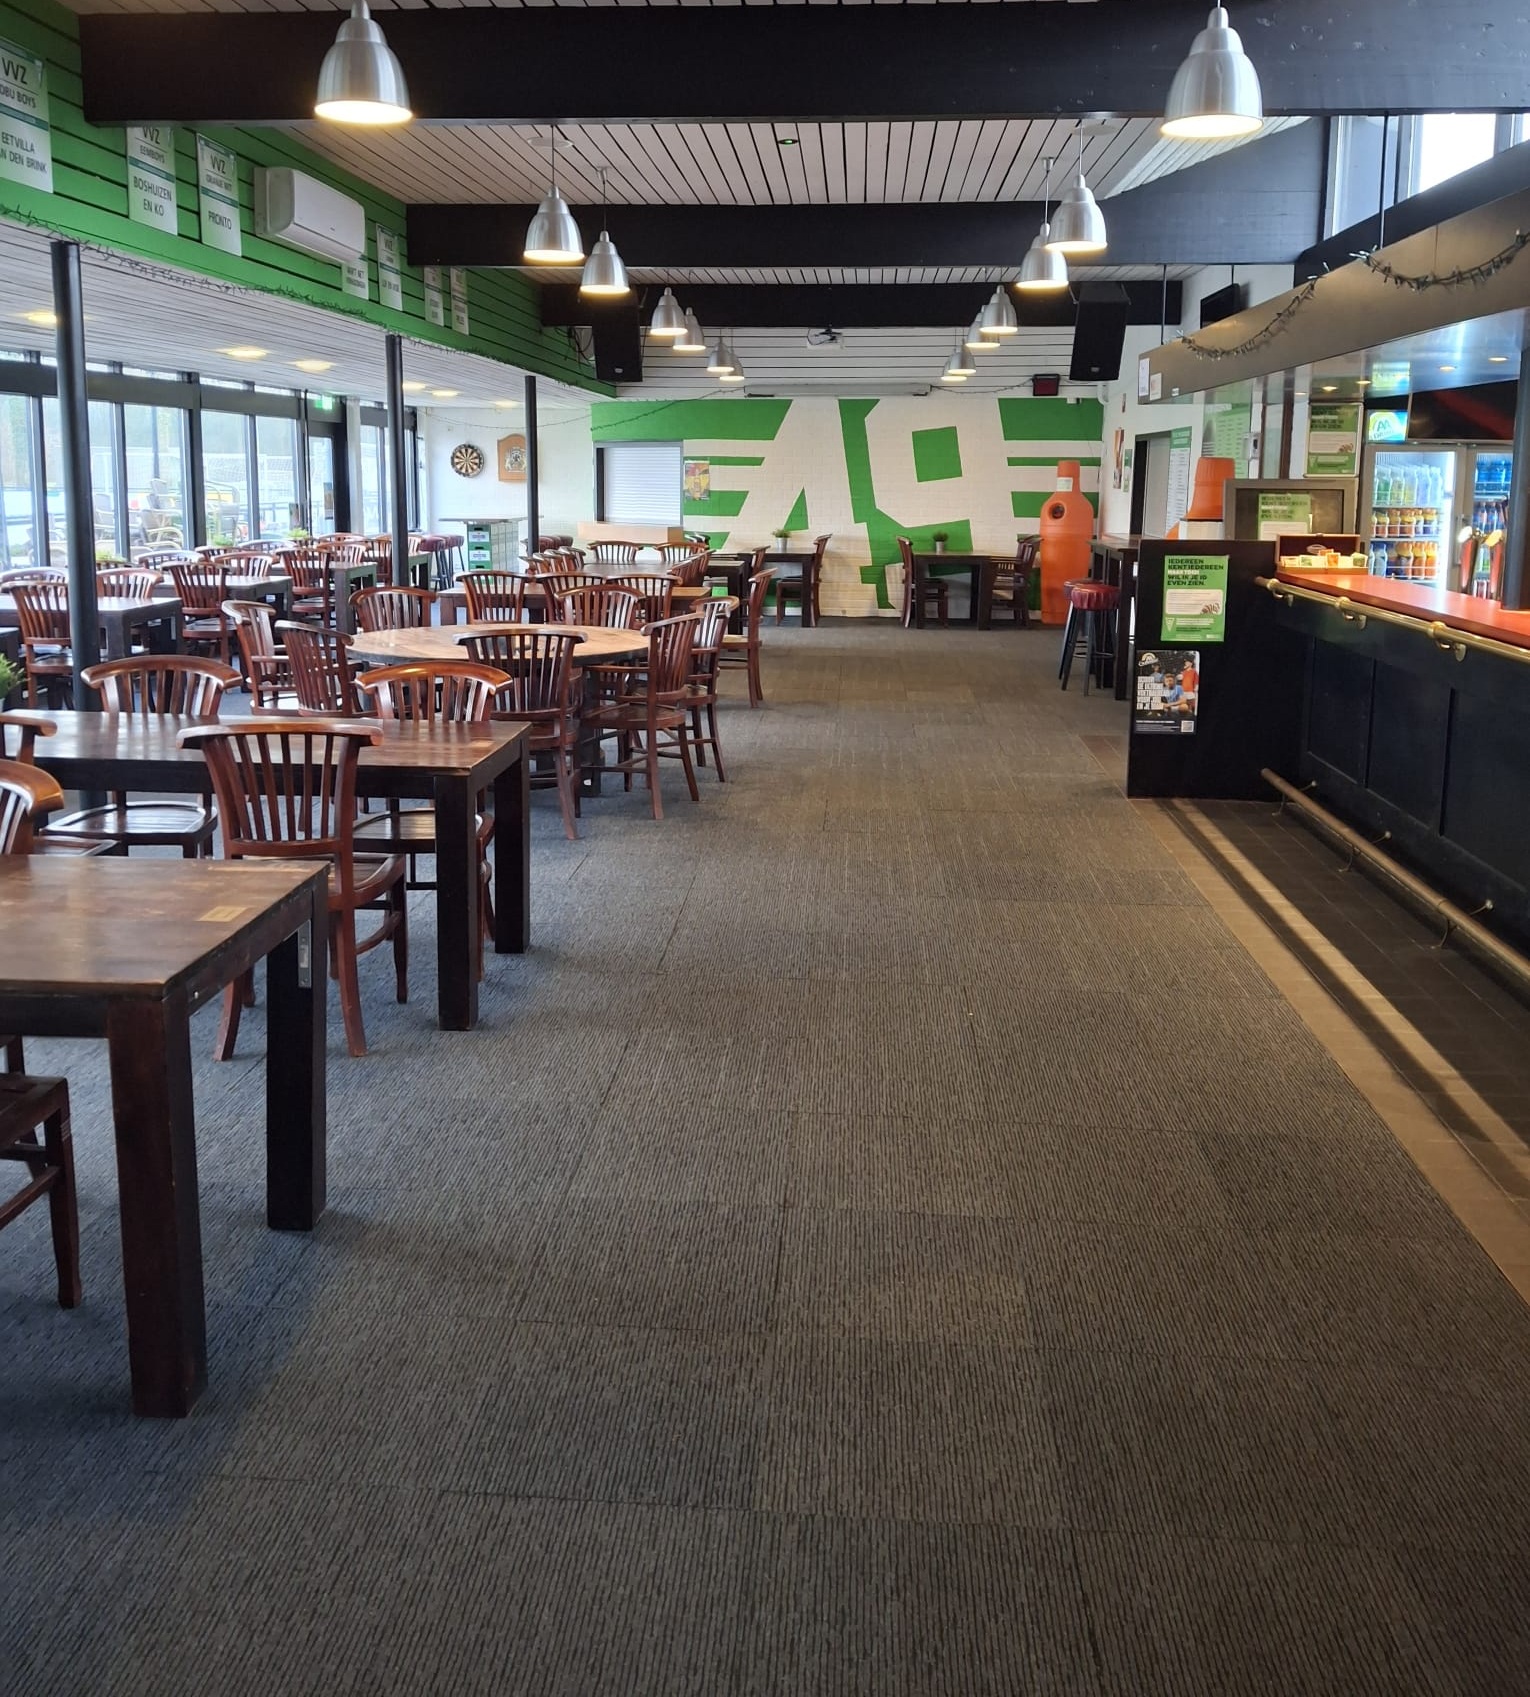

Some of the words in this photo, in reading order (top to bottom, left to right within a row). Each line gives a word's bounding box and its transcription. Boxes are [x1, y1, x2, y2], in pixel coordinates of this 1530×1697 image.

[1, 56, 28, 85] VVZ
[16, 91, 37, 109] BOYS
[1, 131, 35, 154] EETVILLA
[142, 126, 160, 144] VVZ
[9, 151, 24, 165] DEN
[26, 156, 48, 174] BRINK
[210, 154, 226, 174] VVZ
[133, 175, 172, 202] BOSHUIZEN
[143, 198, 153, 213] EN
[154, 202, 165, 217] KO
[208, 210, 232, 230] PRONTO
